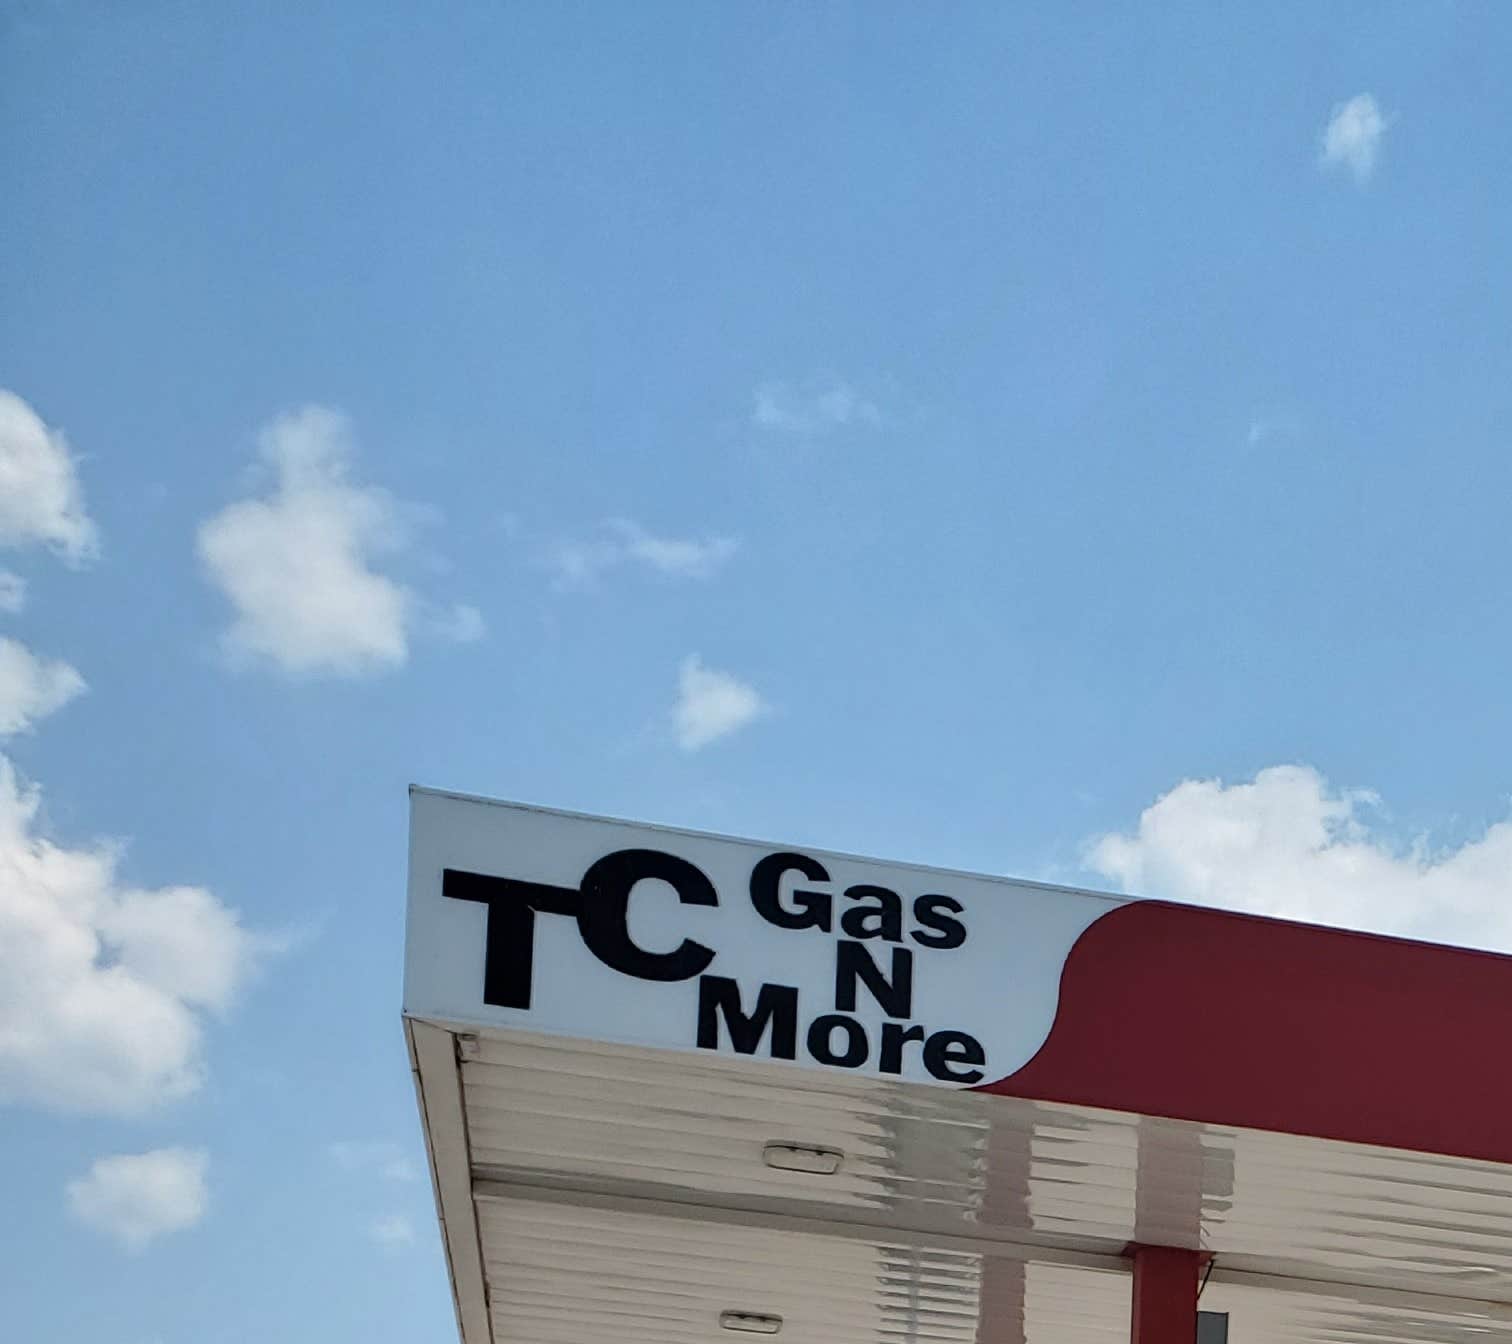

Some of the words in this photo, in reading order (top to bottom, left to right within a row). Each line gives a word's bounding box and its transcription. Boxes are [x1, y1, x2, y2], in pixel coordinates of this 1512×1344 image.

[442, 848, 719, 1010] TC
[749, 851, 967, 950] Gas
[697, 974, 986, 1084] More
[835, 939, 913, 1019] N
